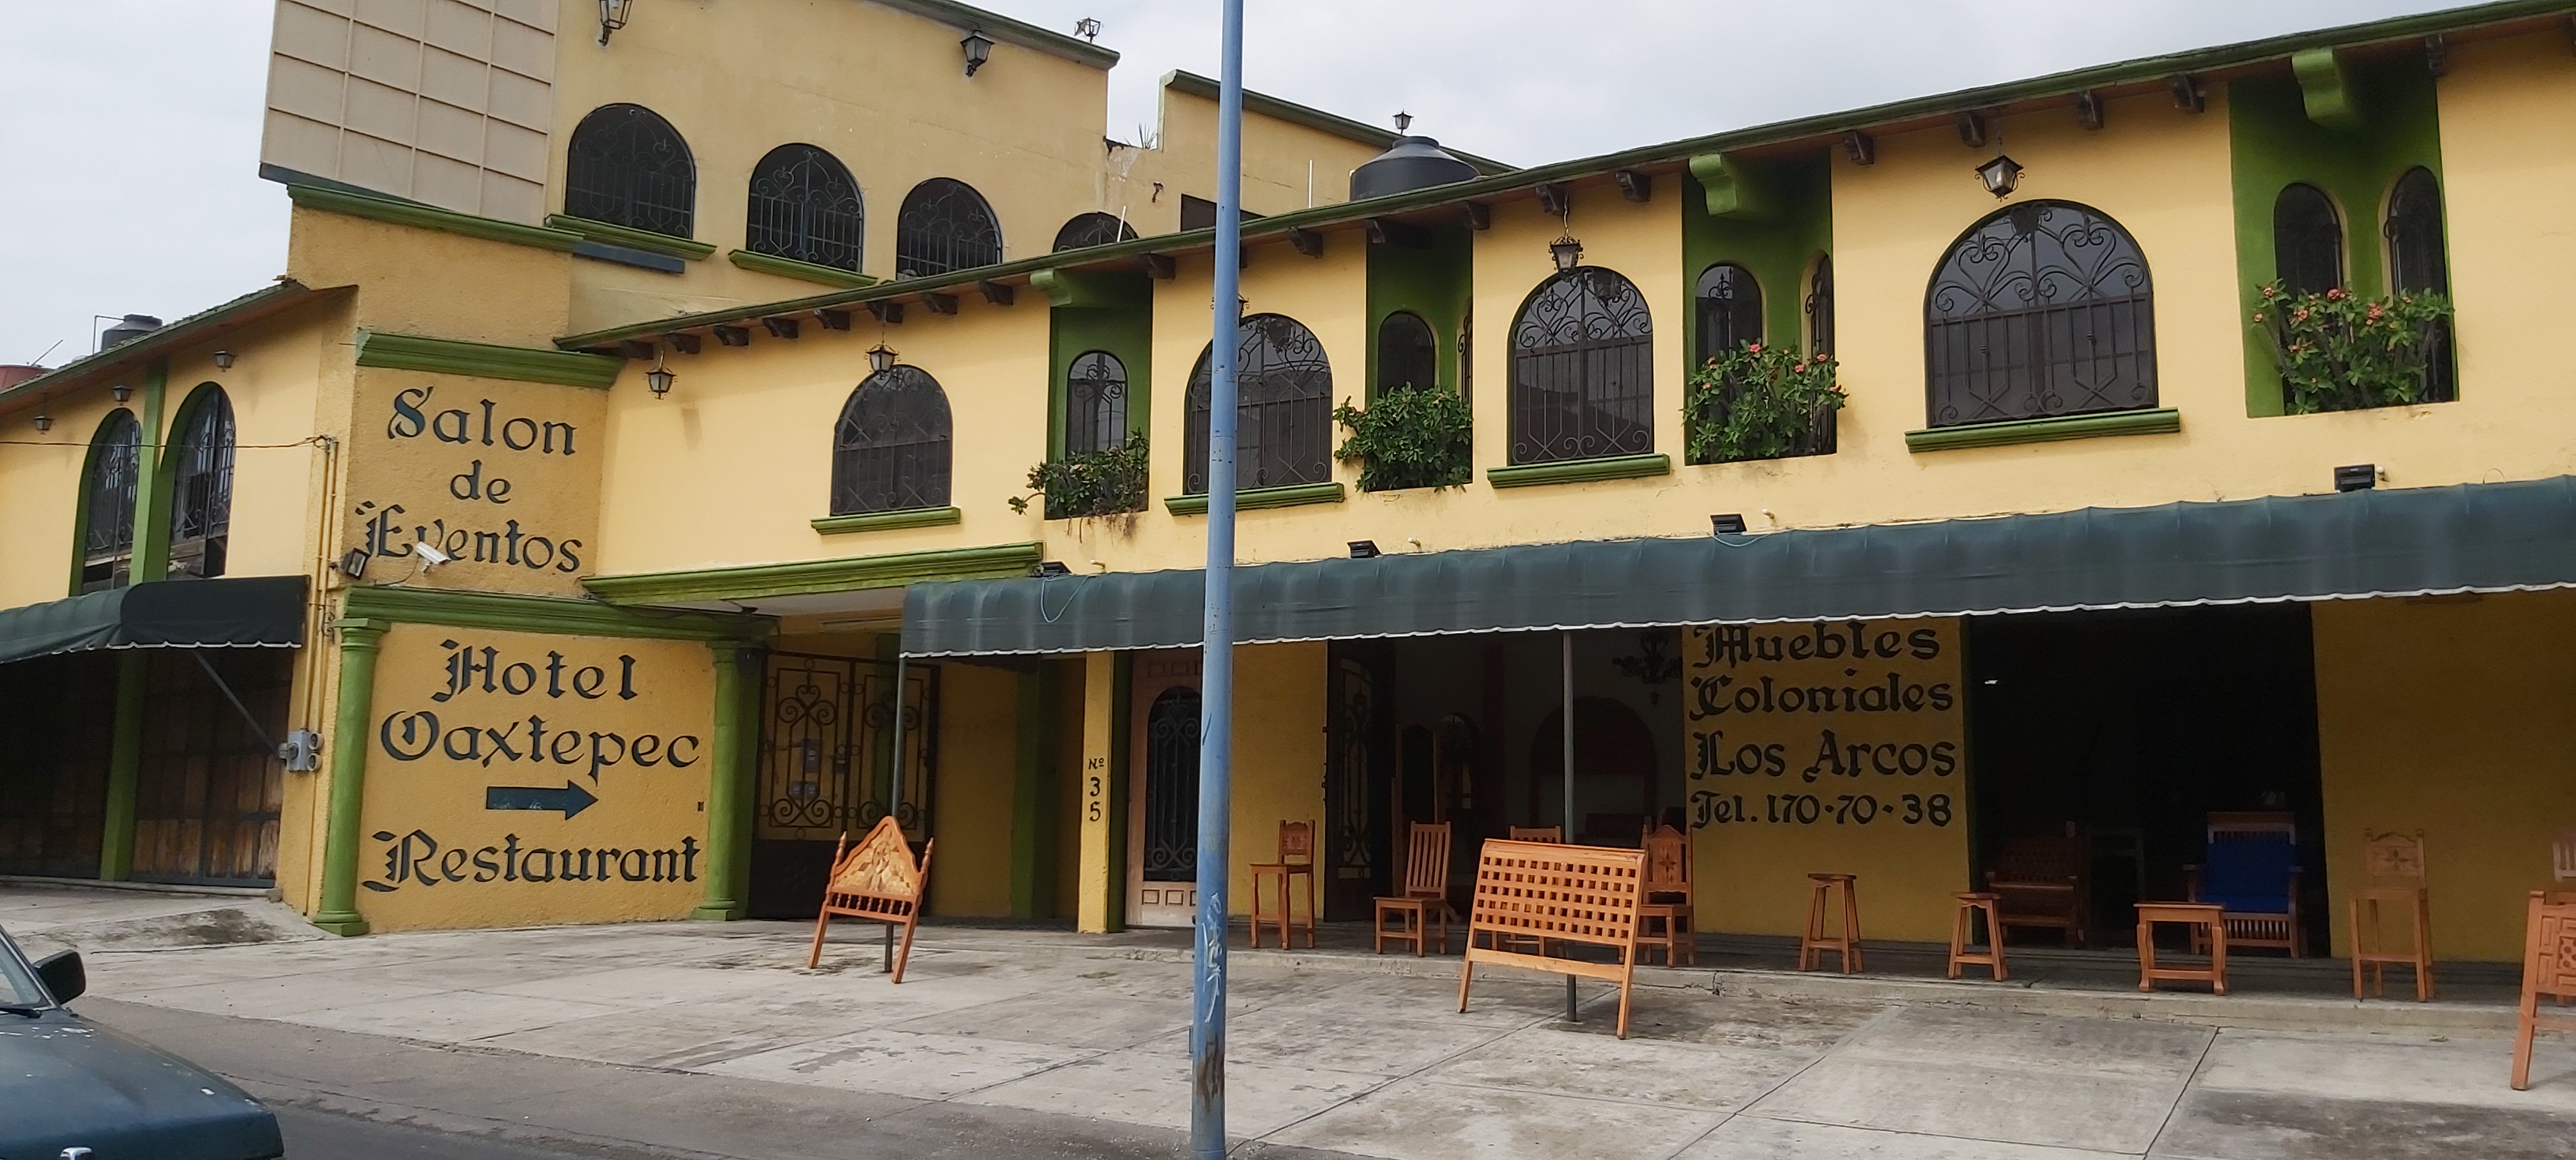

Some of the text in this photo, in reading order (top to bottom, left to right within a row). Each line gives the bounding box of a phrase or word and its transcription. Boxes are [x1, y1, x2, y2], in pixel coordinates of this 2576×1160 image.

[388, 386, 577, 455] Salon
[450, 459, 511, 504] de
[355, 501, 583, 573] Eventos
[431, 639, 638, 703] Hotel
[1692, 622, 1940, 668] Muebles
[1689, 668, 1953, 721] Coloniales
[381, 710, 700, 786] Oaxtepec
[1689, 729, 1956, 783] Los Arcos
[1689, 790, 1758, 830] Tel.
[362, 829, 701, 892] Restaurant
